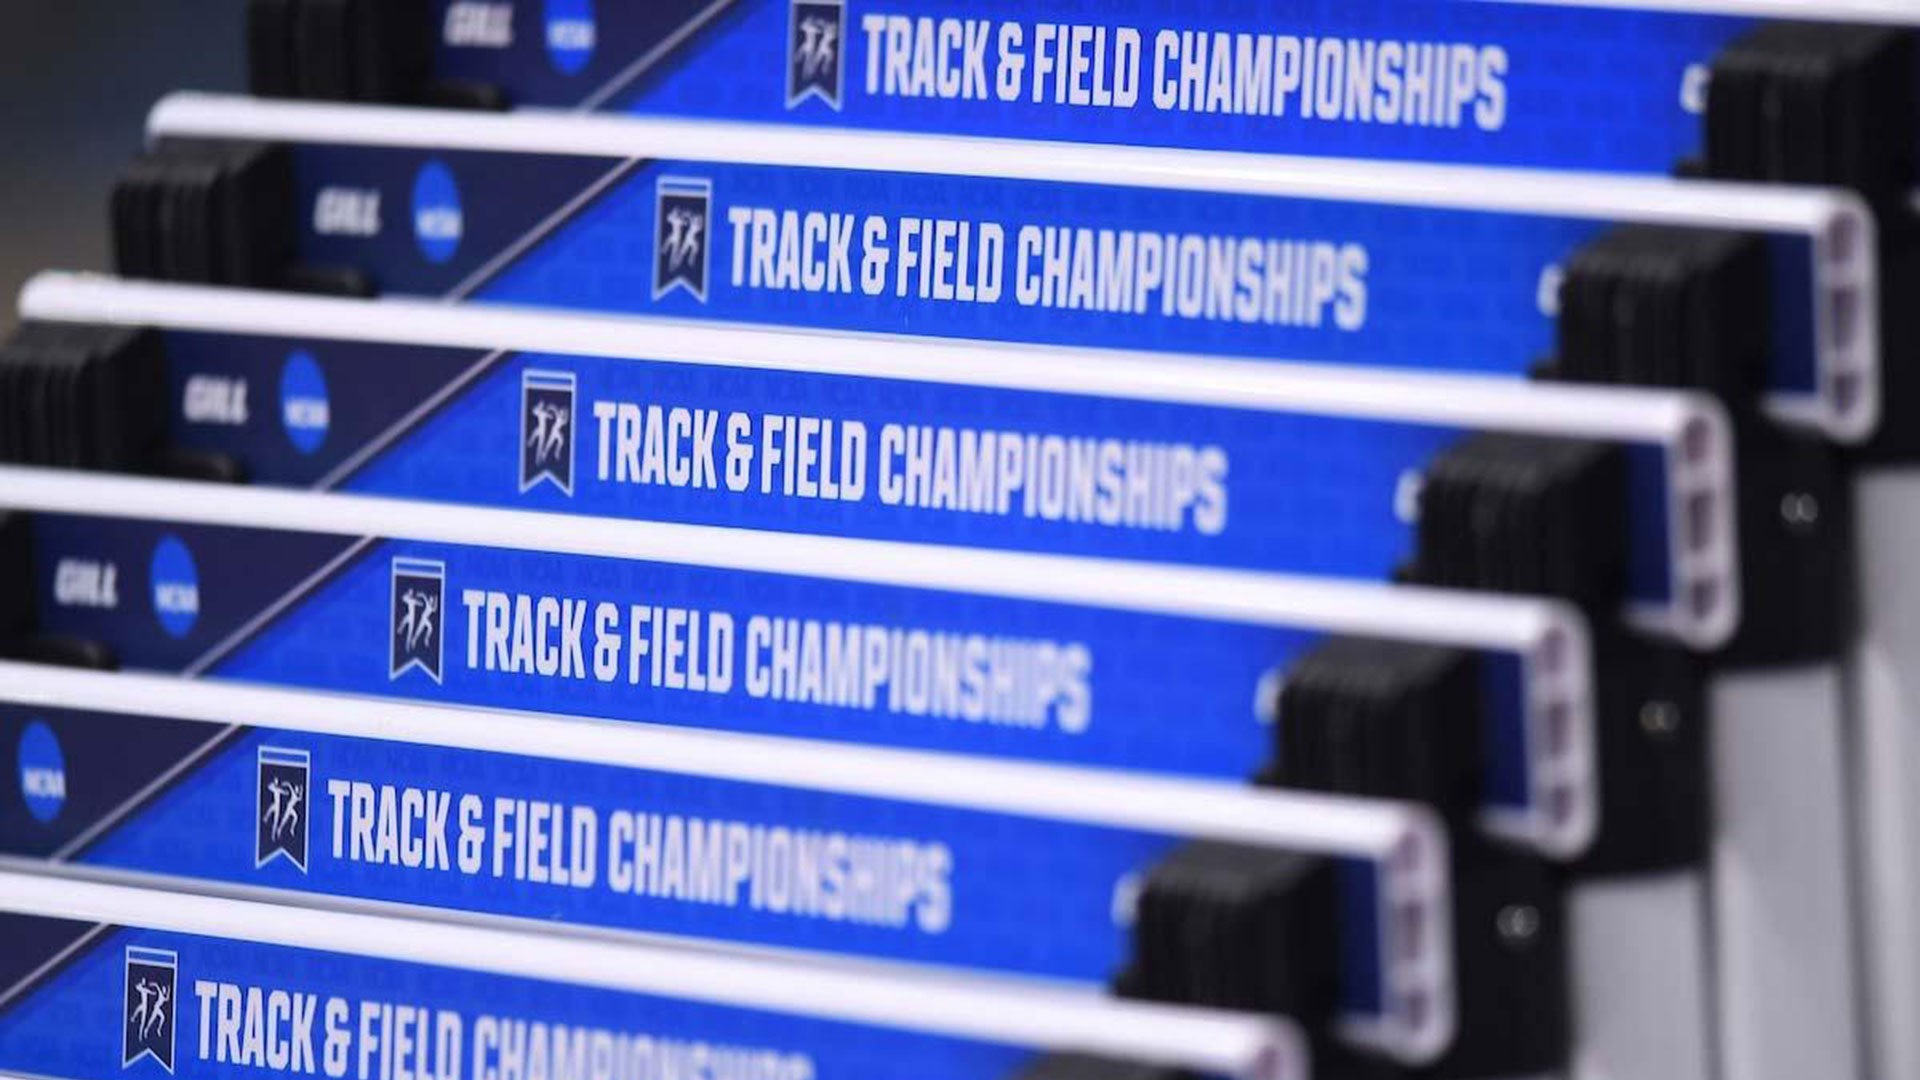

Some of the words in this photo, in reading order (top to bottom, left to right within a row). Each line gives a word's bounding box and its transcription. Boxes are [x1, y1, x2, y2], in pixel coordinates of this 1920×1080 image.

[864, 16, 989, 99] TRACK
[997, 23, 1024, 100] &
[1033, 24, 1140, 107] FIELD
[1154, 30, 1505, 128] CHAMPIONSHIPS
[729, 208, 854, 292] TRACK
[861, 216, 889, 294] &
[897, 218, 1003, 302] FIELD
[1016, 226, 1365, 328] CHAMPIONSHIPS
[594, 402, 718, 488] TRACK
[726, 413, 753, 491] &
[762, 415, 866, 500] FIELD
[878, 424, 1227, 536] CHAMPIONSHIPS
[463, 590, 586, 678] TRACK
[594, 603, 621, 681] &
[630, 606, 733, 692] FIELD
[745, 616, 1090, 734] CHAMPIONSHIPS
[329, 780, 450, 870] TRACK
[459, 795, 485, 873] &
[494, 798, 596, 886] FIELD
[608, 810, 952, 934] CHAMPIONSHIPS
[196, 981, 316, 1073] TRACK
[324, 998, 350, 1076] &
[359, 1002, 461, 1080] FIELD
